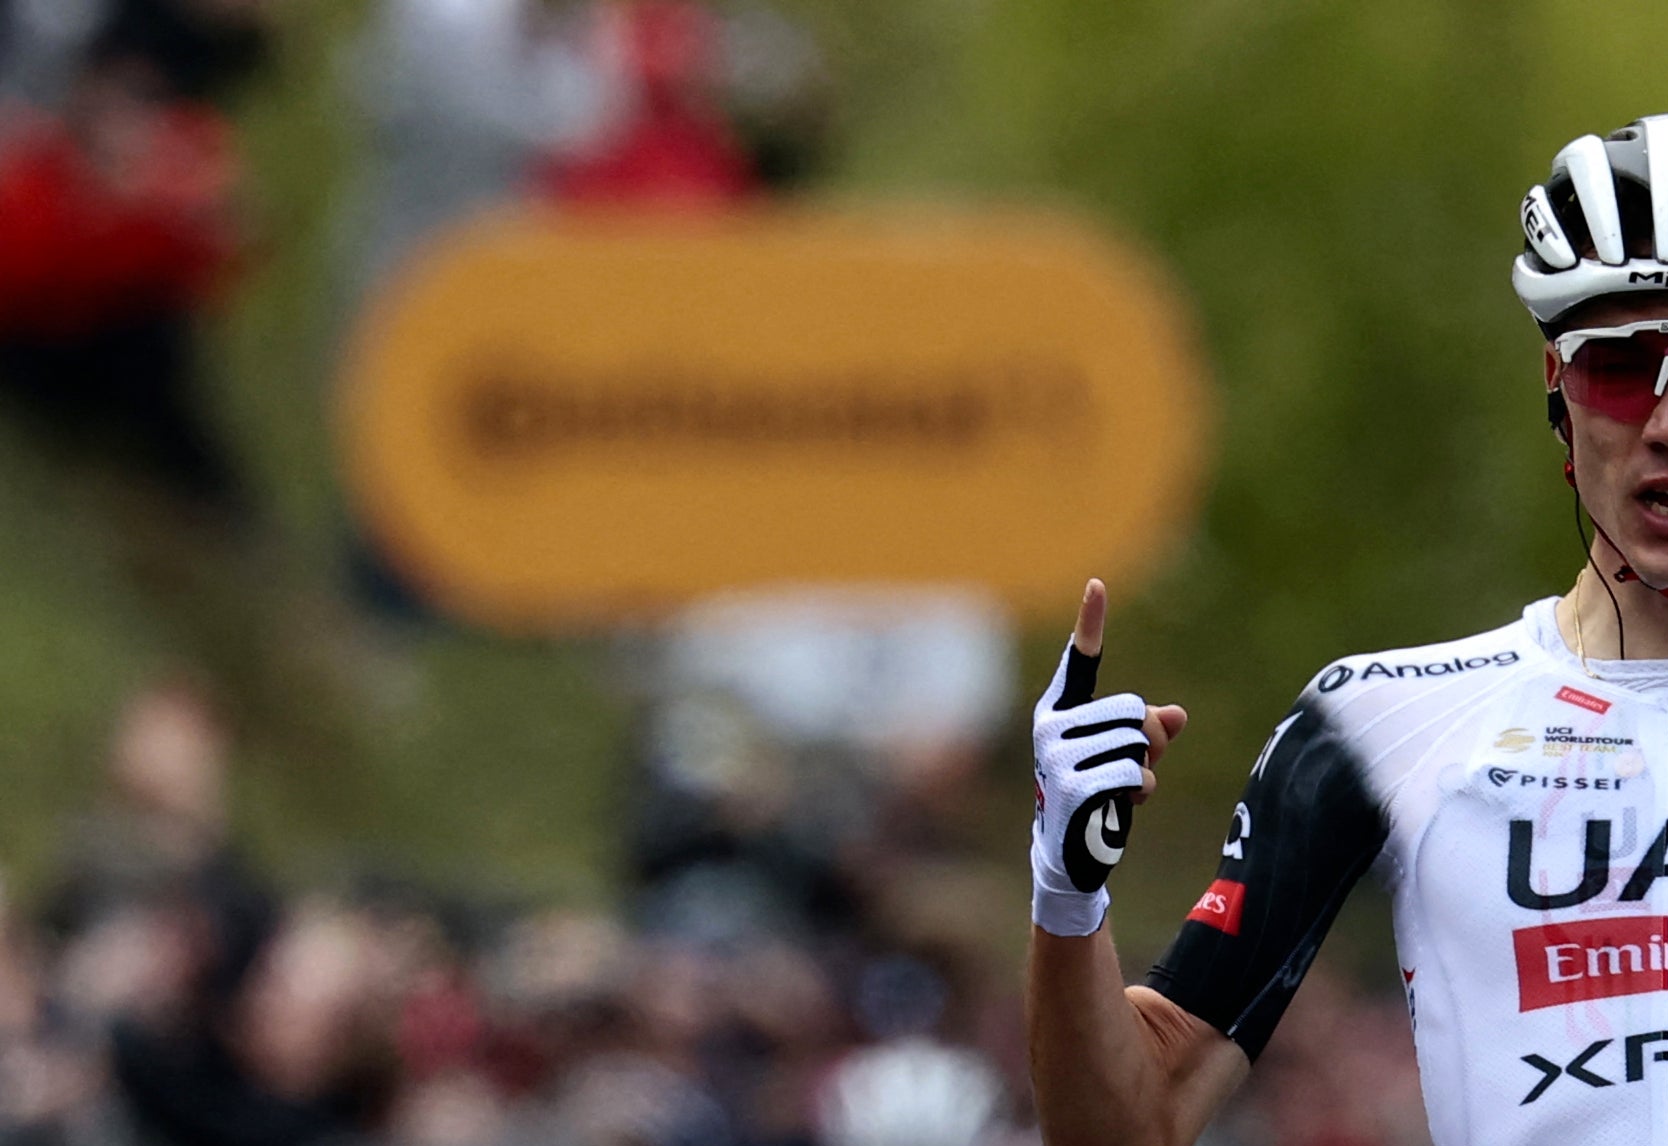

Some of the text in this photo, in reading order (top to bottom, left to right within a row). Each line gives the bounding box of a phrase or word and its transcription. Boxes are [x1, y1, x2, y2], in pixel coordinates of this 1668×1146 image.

[1359, 650, 1521, 680] Analog
[1545, 726, 1574, 735] UCI
[1544, 735, 1634, 746] WORLDTOUR
[1578, 744, 1618, 753] TEAM
[1520, 774, 1623, 791] PISSEI
